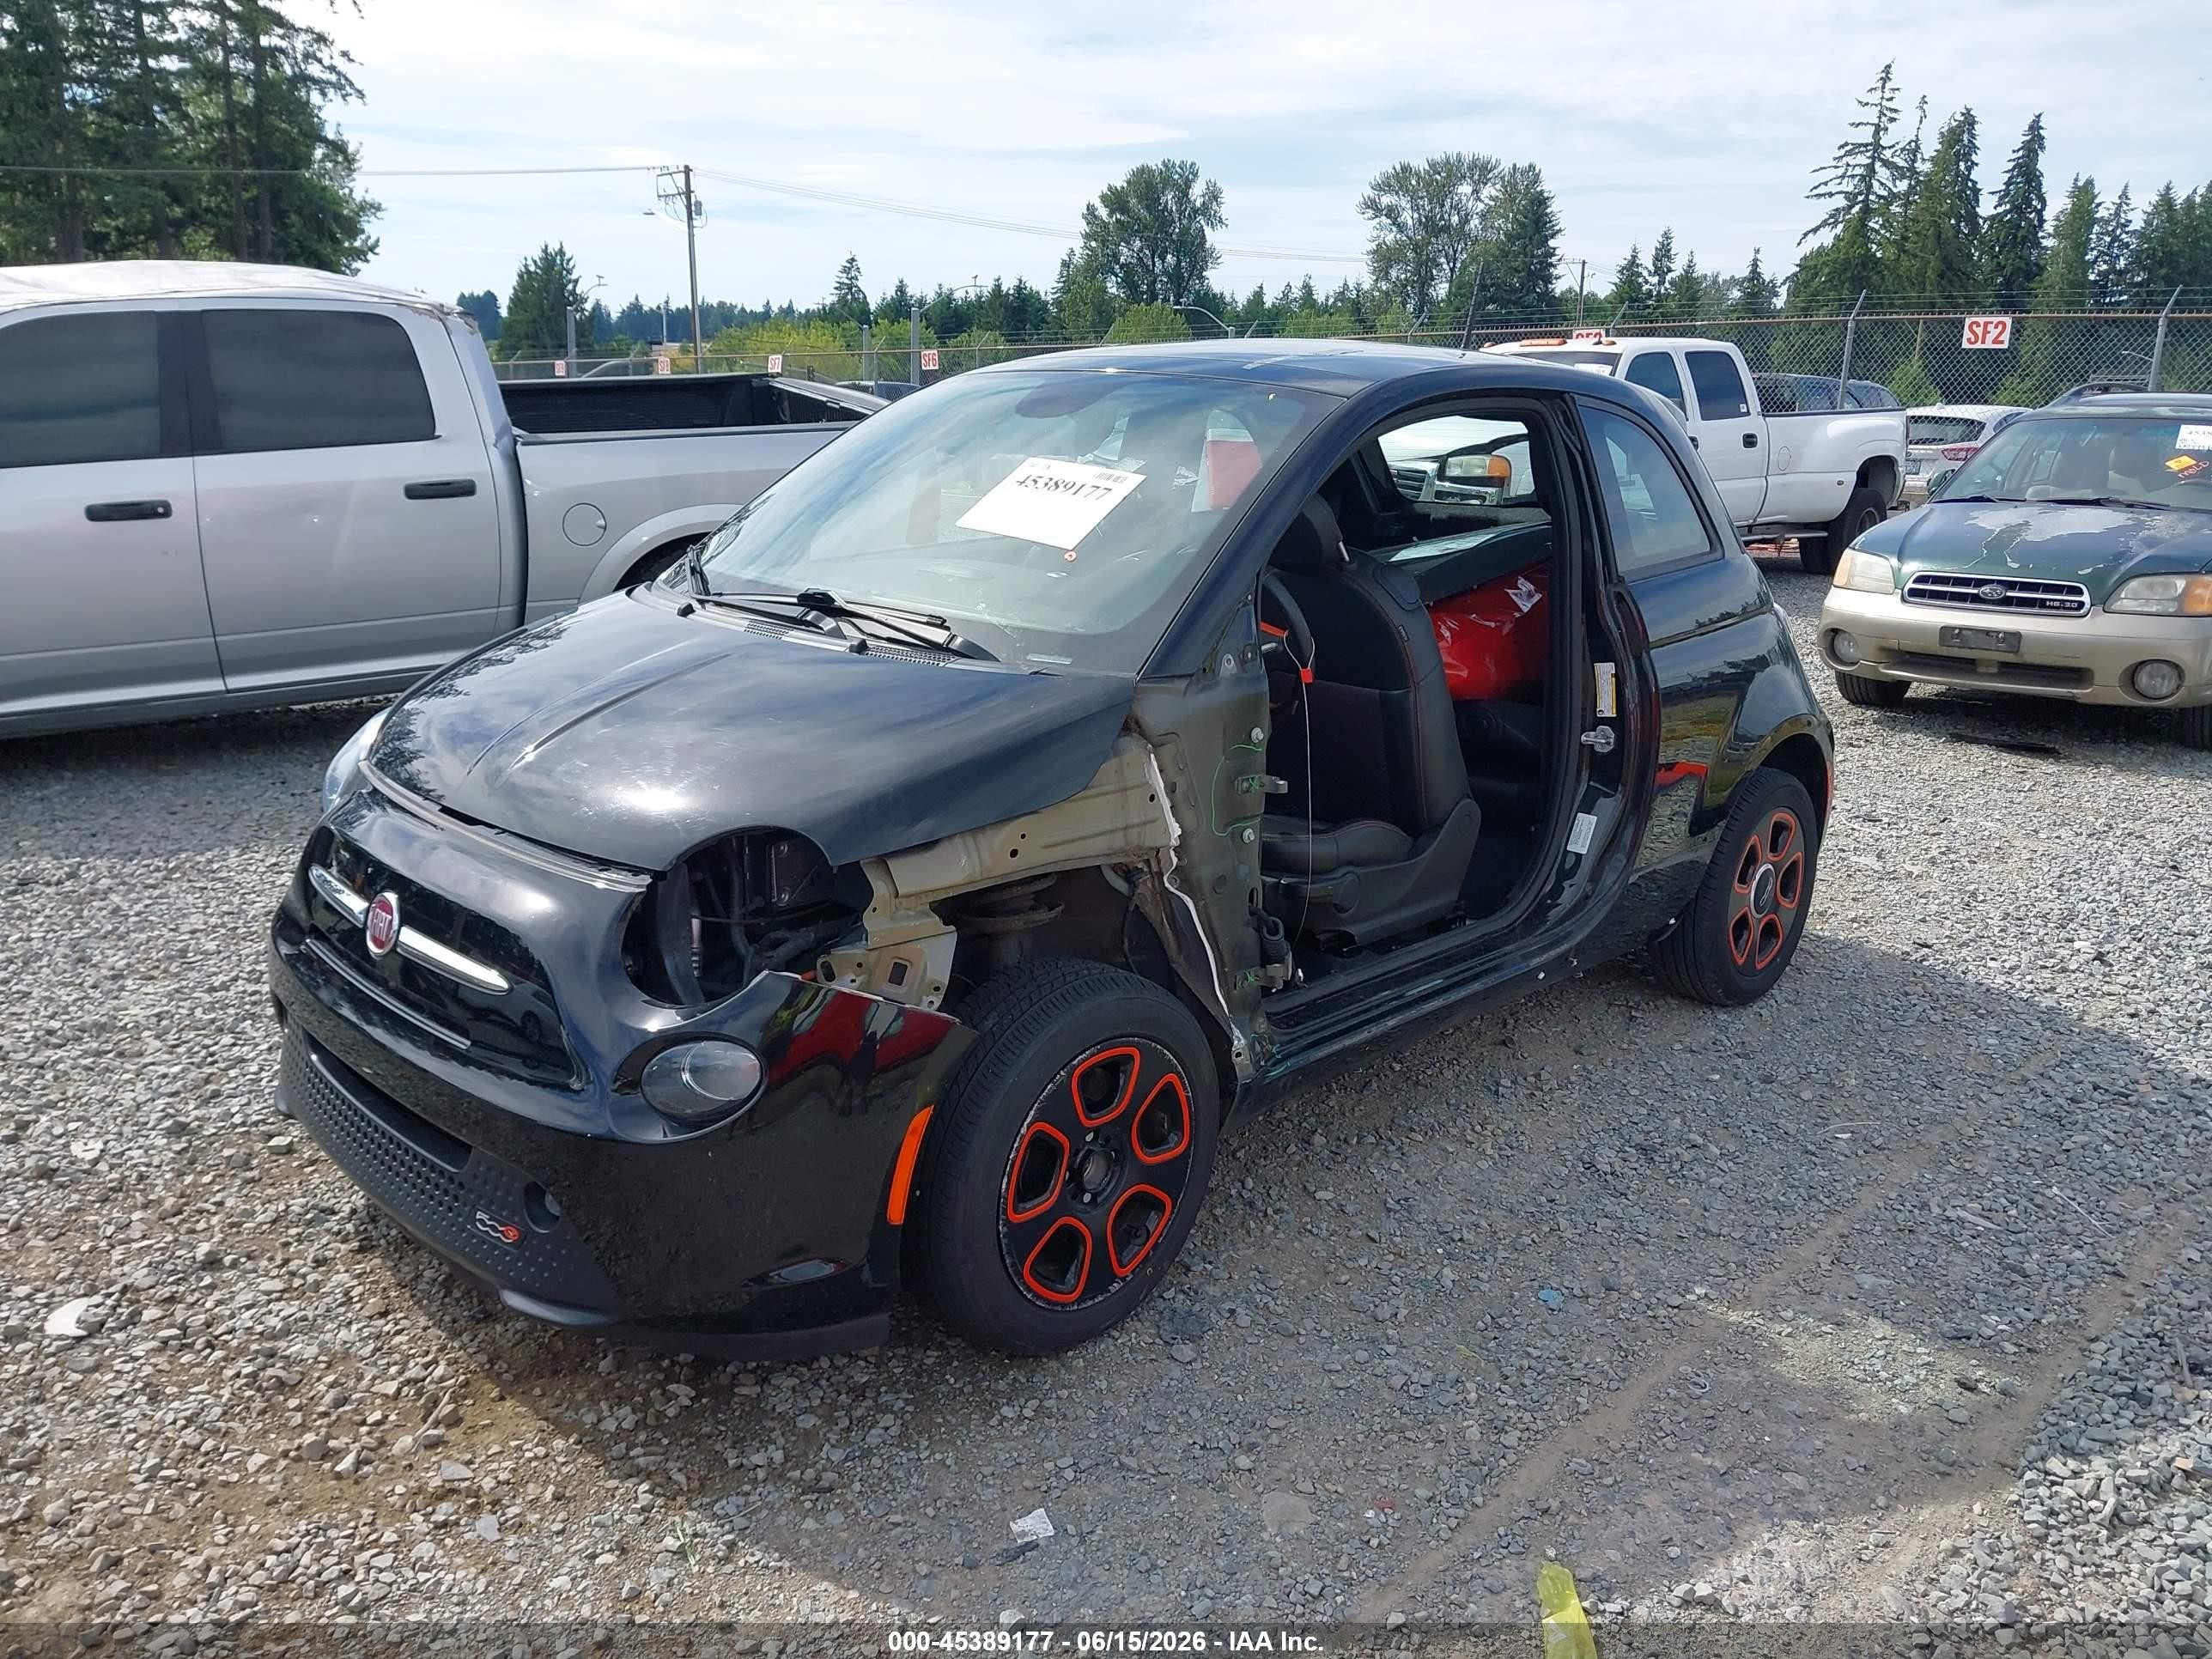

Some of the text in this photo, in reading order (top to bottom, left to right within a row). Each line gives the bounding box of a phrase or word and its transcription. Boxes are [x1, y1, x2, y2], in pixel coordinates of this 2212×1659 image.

[1966, 320, 2007, 345] SF2
[769, 356, 780, 371] SF7
[922, 352, 937, 368] SF6
[1016, 474, 1113, 501] 45389177
[371, 908, 392, 942] FIAT
